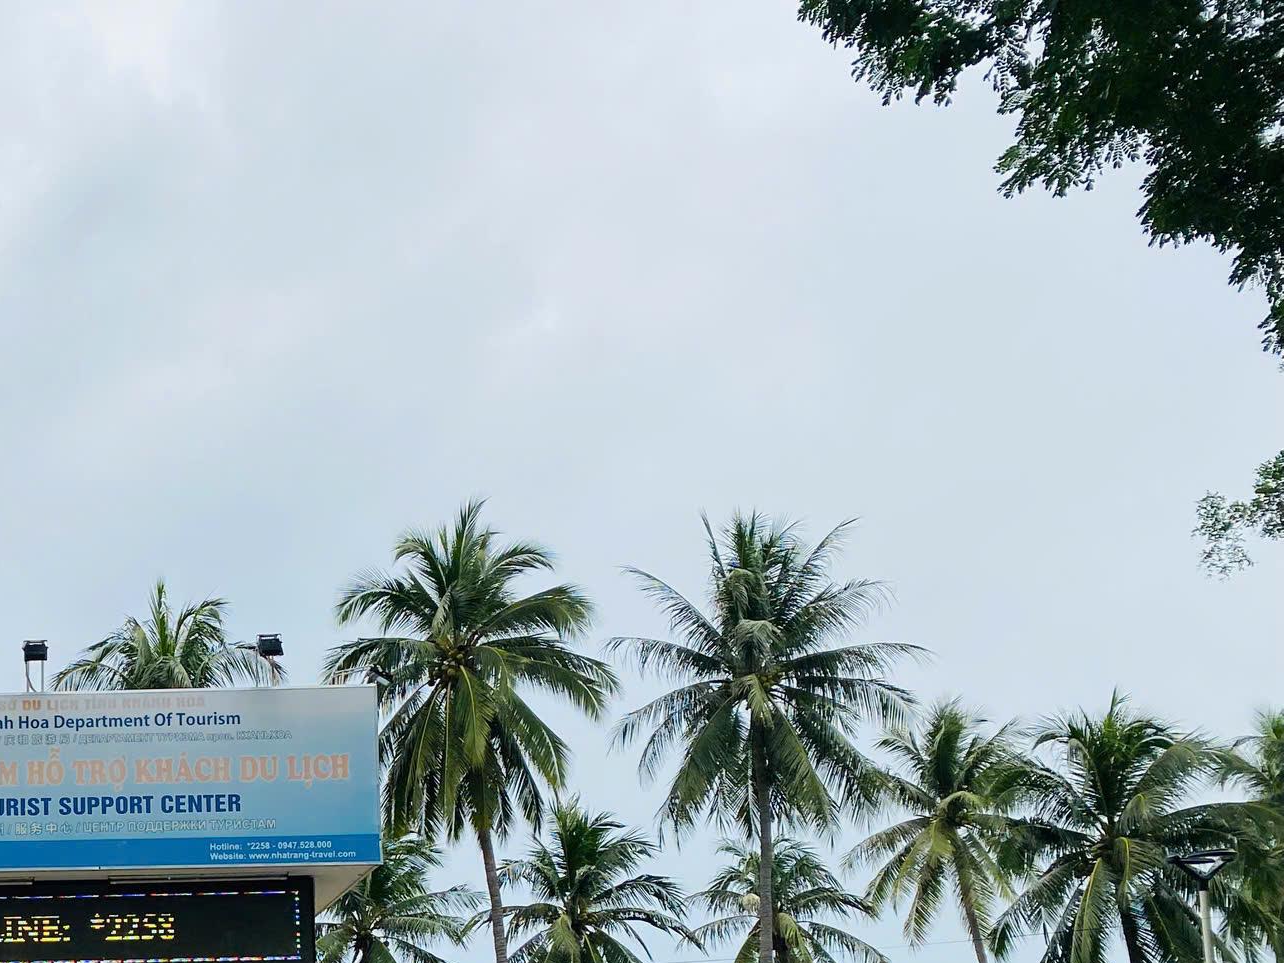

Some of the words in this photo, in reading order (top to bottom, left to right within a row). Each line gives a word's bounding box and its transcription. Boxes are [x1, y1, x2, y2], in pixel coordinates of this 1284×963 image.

[22, 699, 42, 711] DU
[18, 716, 49, 729] Hoa
[54, 713, 149, 731] Department
[155, 712, 173, 727] Of
[176, 711, 241, 726] Tourism
[27, 747, 64, 785] HỖ
[72, 755, 127, 792] TRỢ
[135, 753, 231, 783] KHÁCH
[239, 756, 278, 781] DU
[287, 753, 350, 789] LỊCH
[59, 796, 154, 816] SUPPORT
[160, 794, 241, 813] CENTER
[14, 821, 73, 836] 服务中心
[83, 821, 125, 834] ЦЕНТР
[128, 820, 206, 834] ПОДДЕРЖКИ
[210, 818, 276, 831] ТУРИСТАМ
[209, 843, 242, 852] Hotline:
[277, 840, 332, 850] 0947.528.000
[209, 852, 247, 861] Website:
[248, 850, 356, 861] www.nhatrang-travel.com
